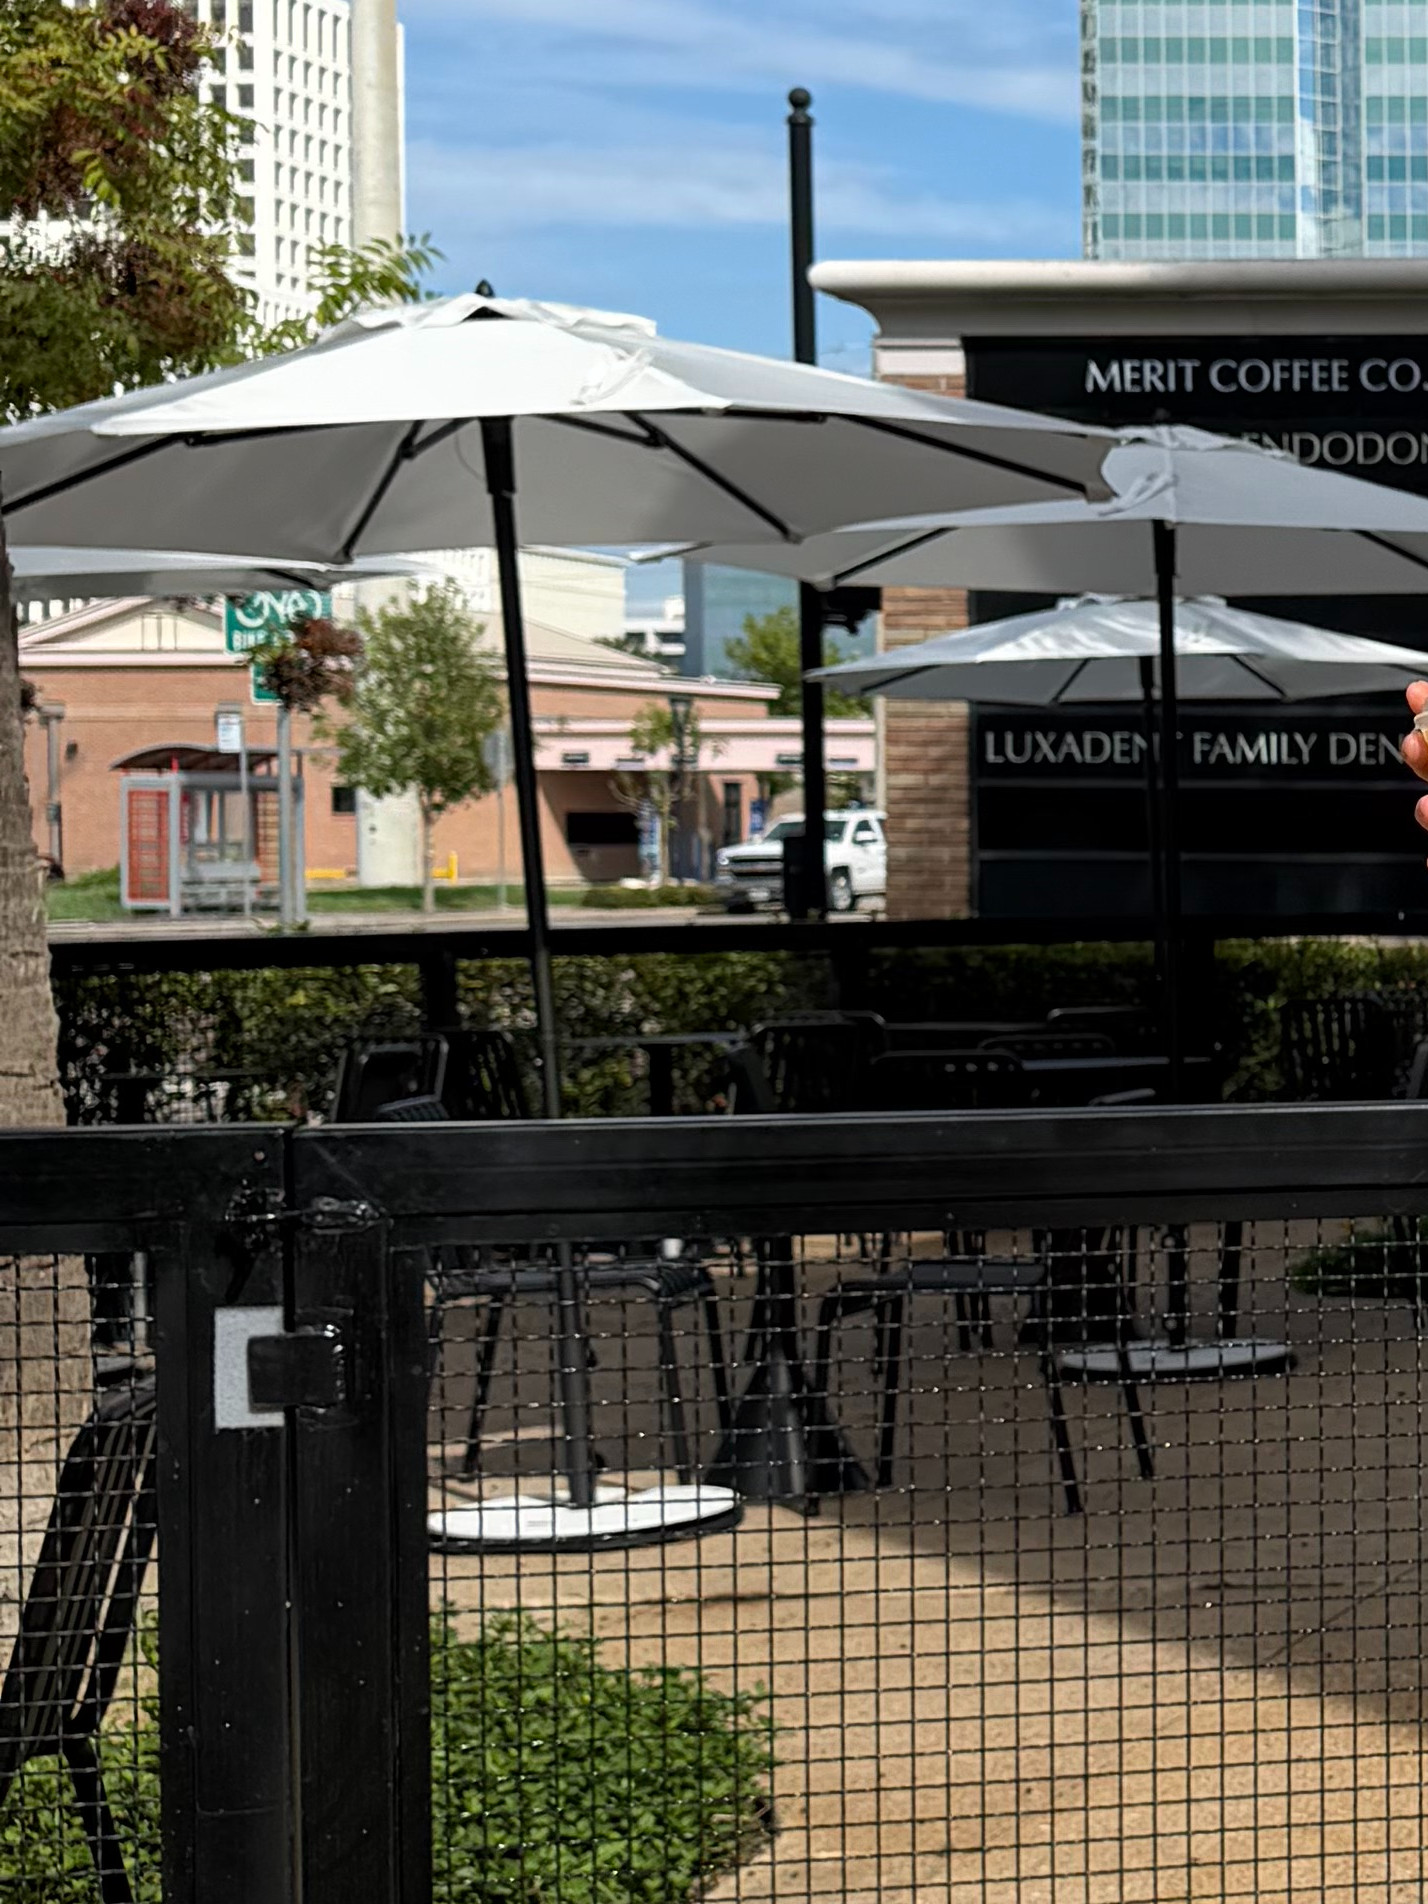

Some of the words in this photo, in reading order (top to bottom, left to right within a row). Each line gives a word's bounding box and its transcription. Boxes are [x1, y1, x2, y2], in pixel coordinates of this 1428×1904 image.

[1085, 359, 1200, 393] MERIT
[1209, 359, 1349, 393] COFFEE
[985, 731, 1184, 764] LUXADEN
[1193, 731, 1316, 765] FAMILY
